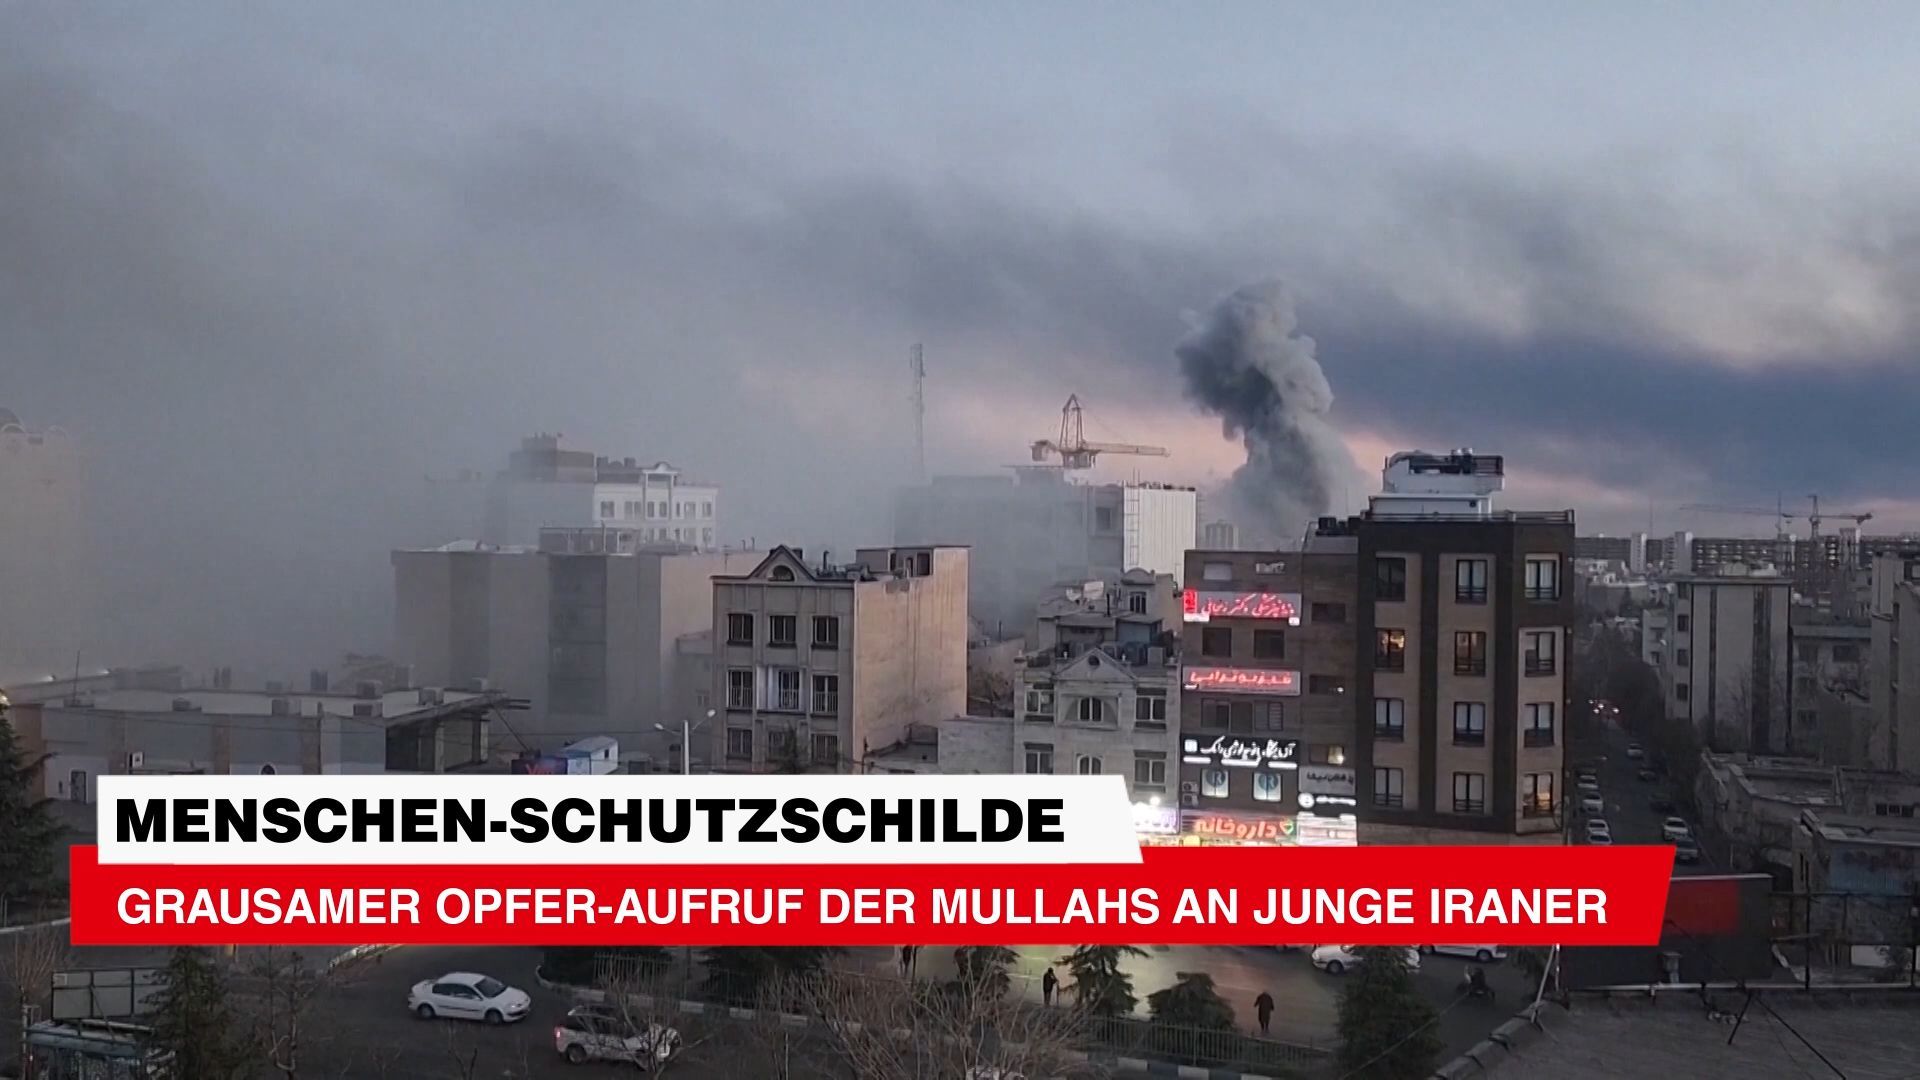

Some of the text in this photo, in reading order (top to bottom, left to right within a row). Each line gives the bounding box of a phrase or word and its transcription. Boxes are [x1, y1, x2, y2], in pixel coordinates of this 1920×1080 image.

[1226, 593, 1257, 616] دکتر
[1190, 669, 1292, 687] فیزیوتراپی
[1195, 817, 1278, 839] داروخانه
